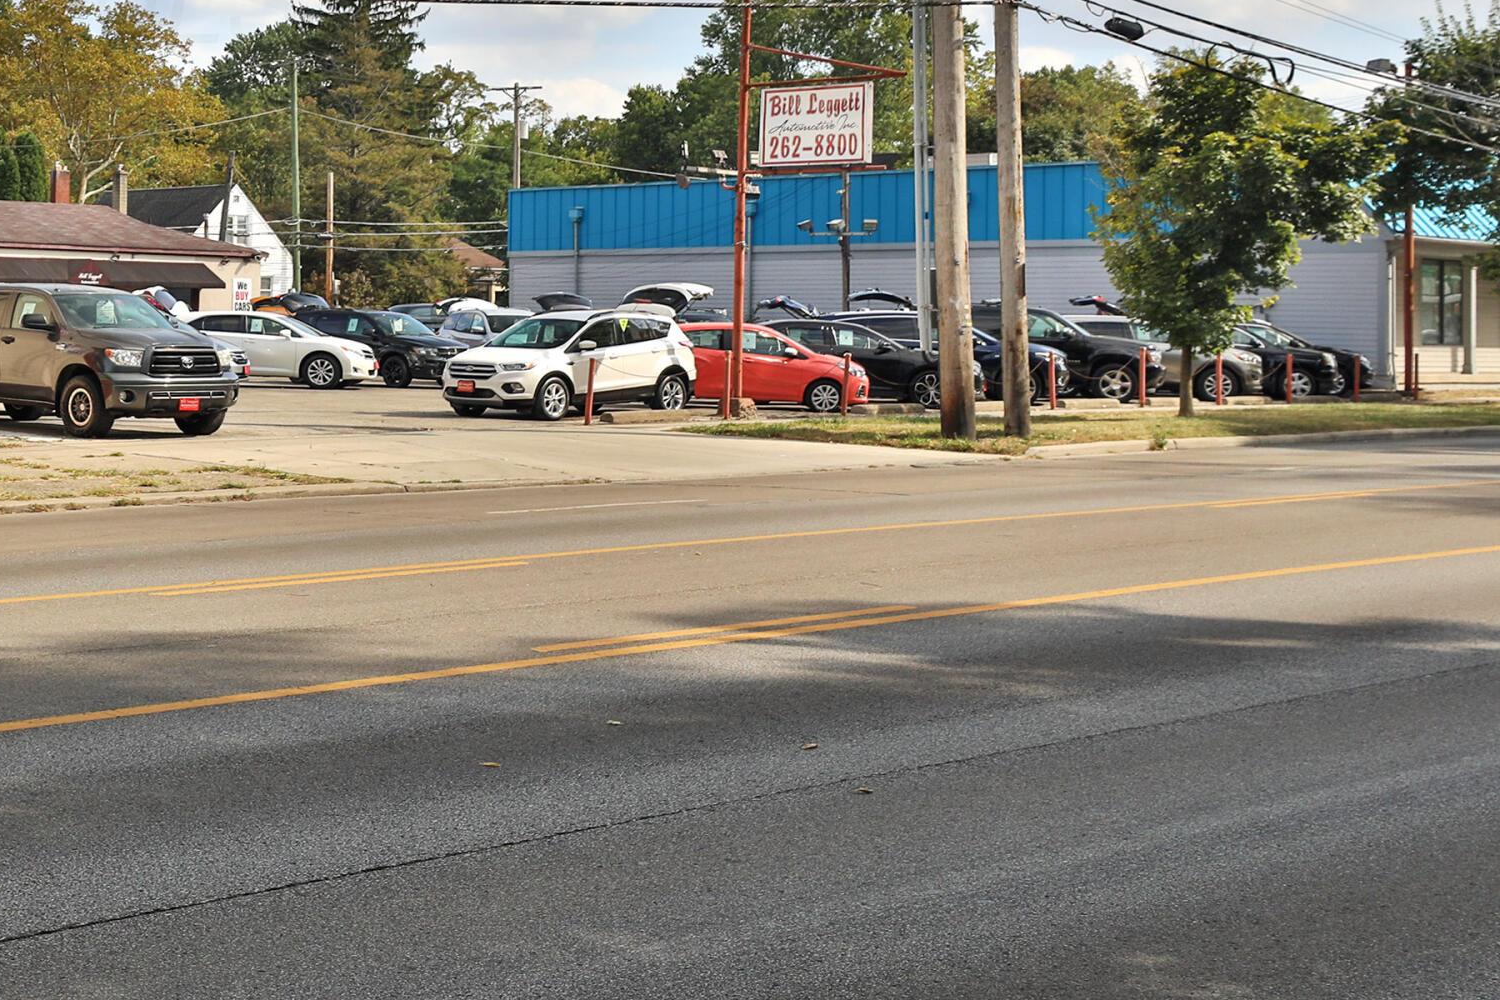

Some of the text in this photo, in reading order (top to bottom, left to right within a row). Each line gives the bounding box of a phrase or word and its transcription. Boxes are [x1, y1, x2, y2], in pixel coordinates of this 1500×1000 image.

[769, 91, 861, 118] Bill Leggett
[768, 119, 836, 136] Automotive
[769, 132, 858, 159] 262-8800
[237, 281, 248, 290] We
[235, 291, 249, 301] BUY
[234, 302, 251, 312] CARS
